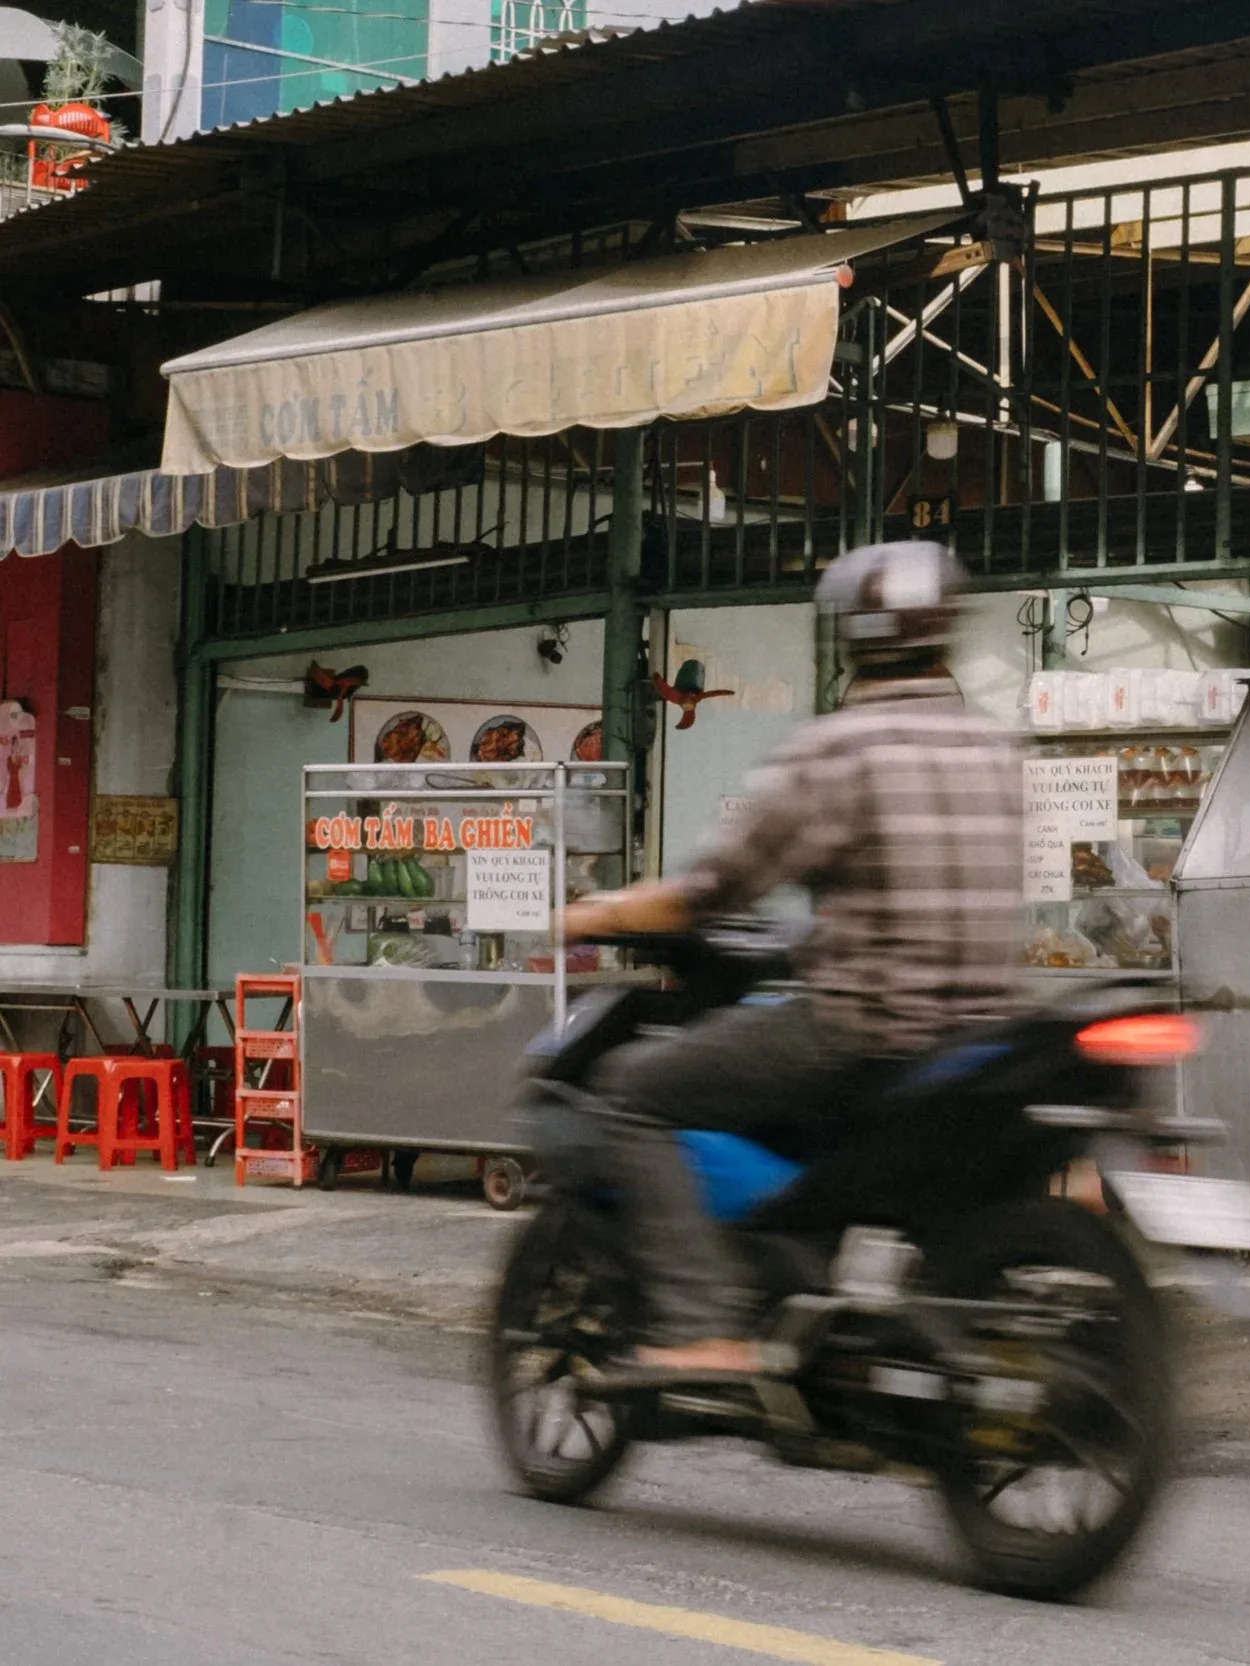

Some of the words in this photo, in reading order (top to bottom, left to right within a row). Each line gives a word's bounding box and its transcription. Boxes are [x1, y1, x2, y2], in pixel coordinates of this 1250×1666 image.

[912, 498, 950, 528] 84
[1028, 766, 1046, 775] XIN
[1032, 782, 1052, 793] VUI
[1072, 800, 1093, 811] COI
[1096, 800, 1112, 811] XE
[315, 810, 362, 849] CƠM
[364, 802, 413, 849] TẤM
[423, 817, 456, 850] BA
[460, 801, 532, 850] GHIỀN
[1036, 825, 1058, 833] CANH
[531, 890, 545, 901] XE
